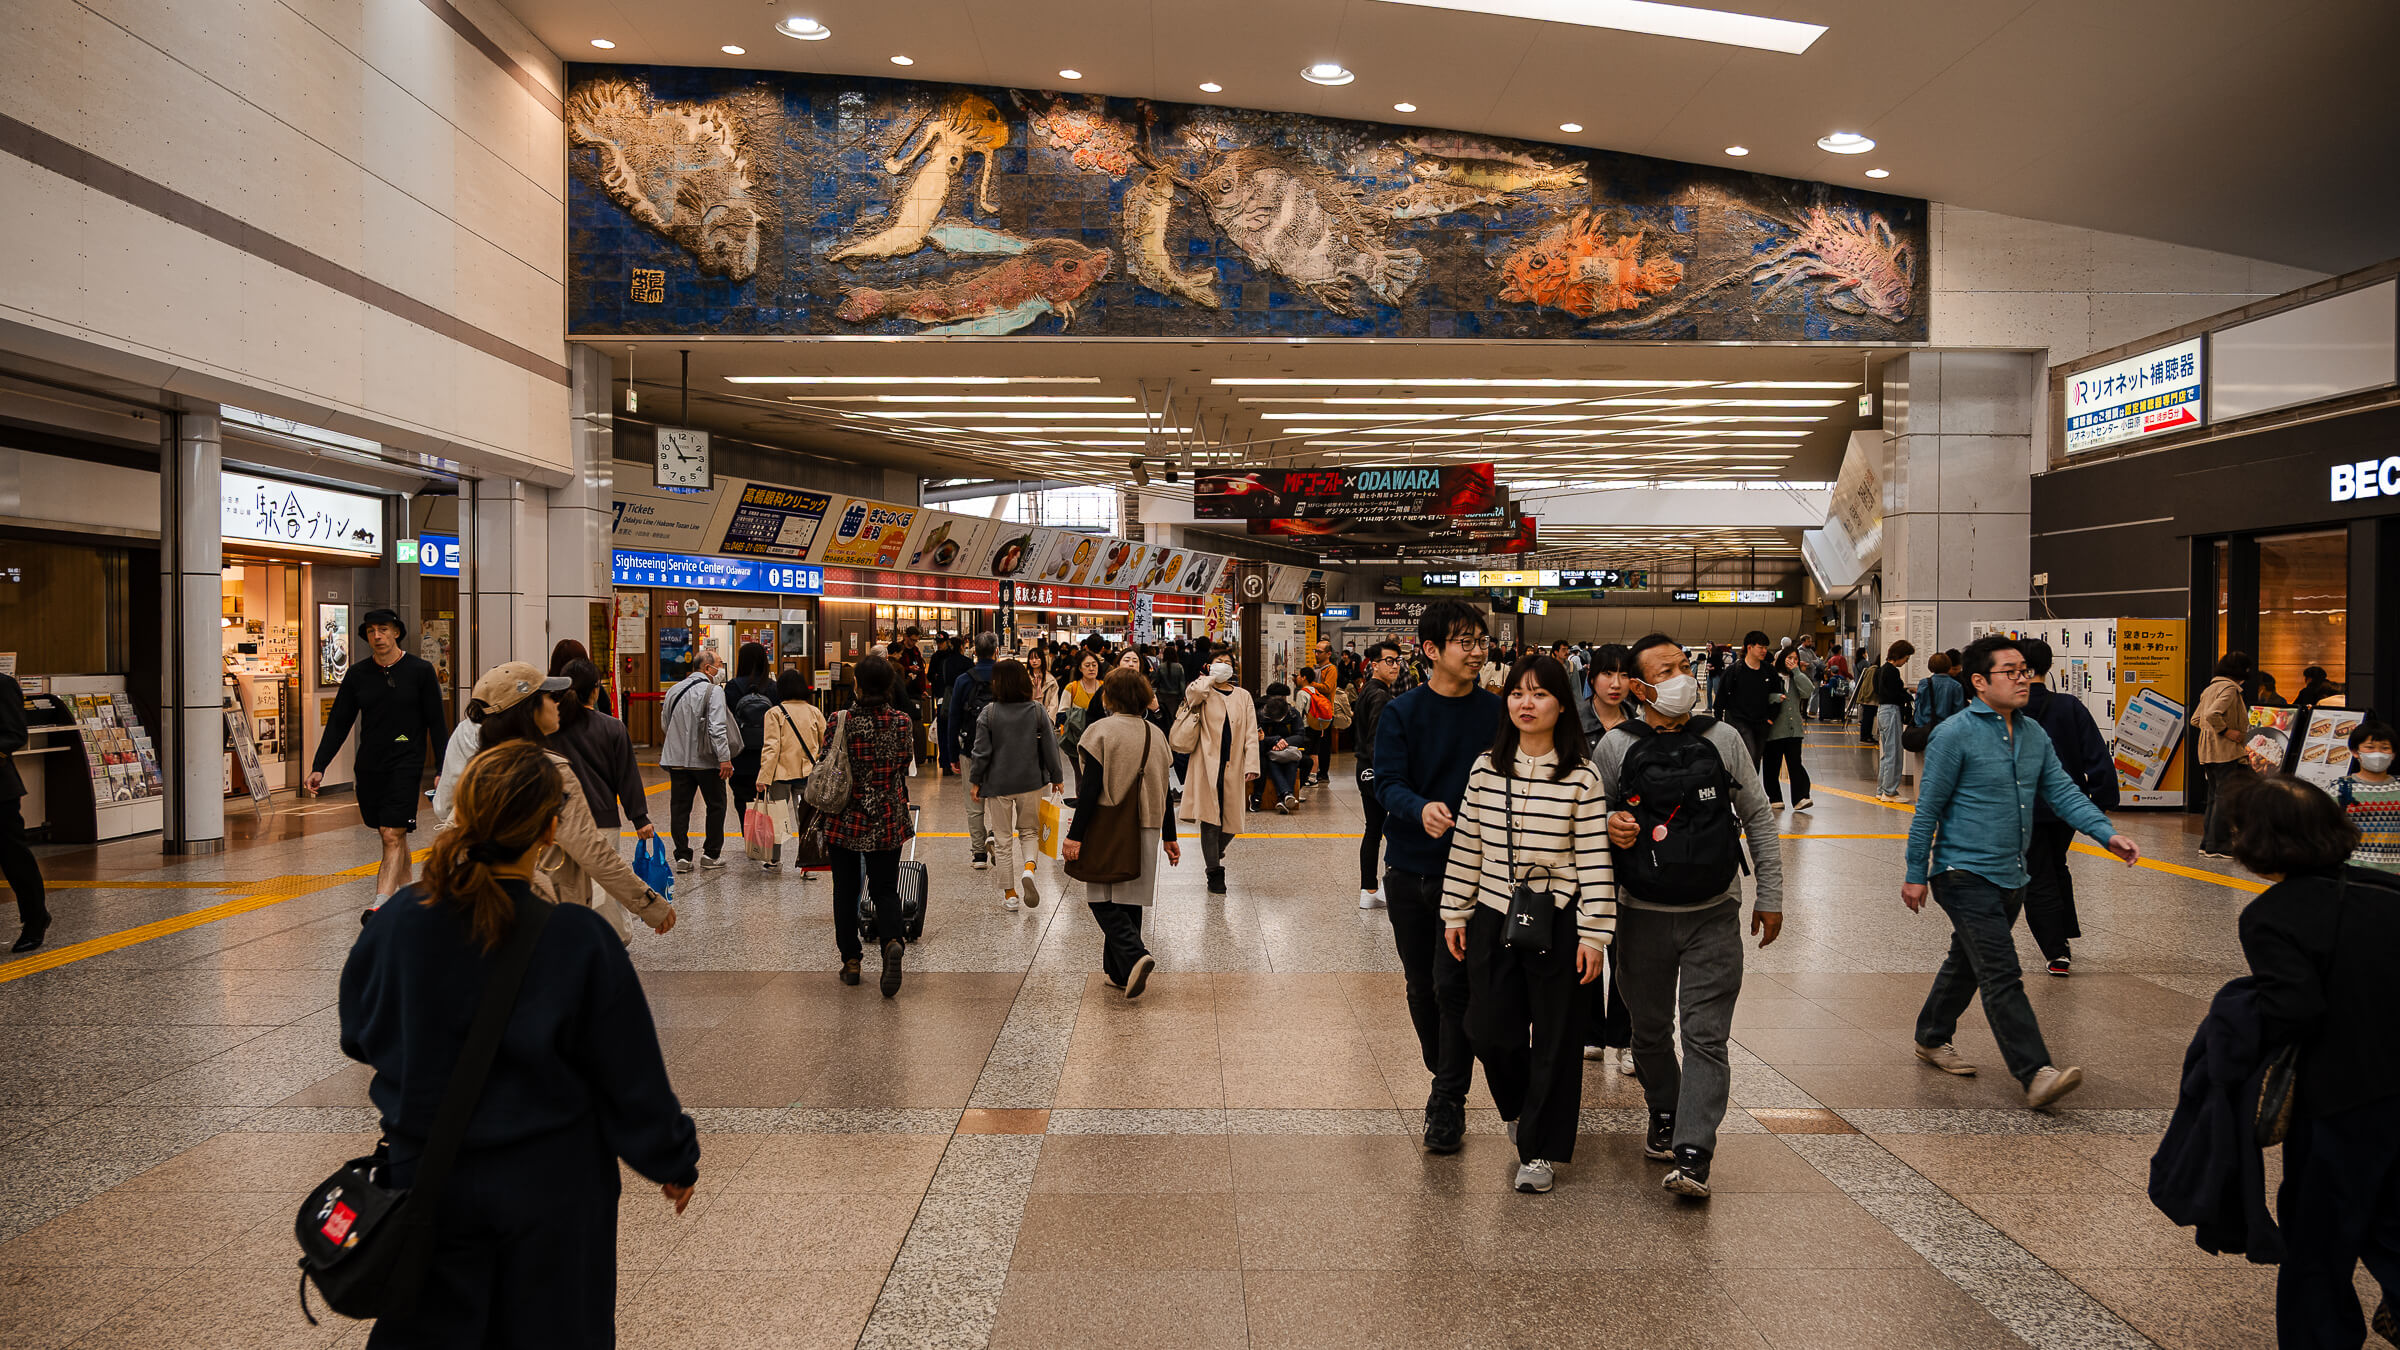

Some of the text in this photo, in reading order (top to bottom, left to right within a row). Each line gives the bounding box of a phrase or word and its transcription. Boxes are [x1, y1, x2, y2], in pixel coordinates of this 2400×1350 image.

[2092, 352, 2194, 401] リオネット補聴器
[2069, 423, 2119, 442] リオネットセンター
[1357, 469, 1440, 491] ODAWARA
[627, 504, 655, 515] Tickets
[742, 487, 827, 512] 高橋眼科クリニック
[623, 516, 641, 526] Odakyu
[615, 554, 751, 576] Sightseeing Service Center Odawara
[2123, 630, 2174, 639] 空きロッカー
